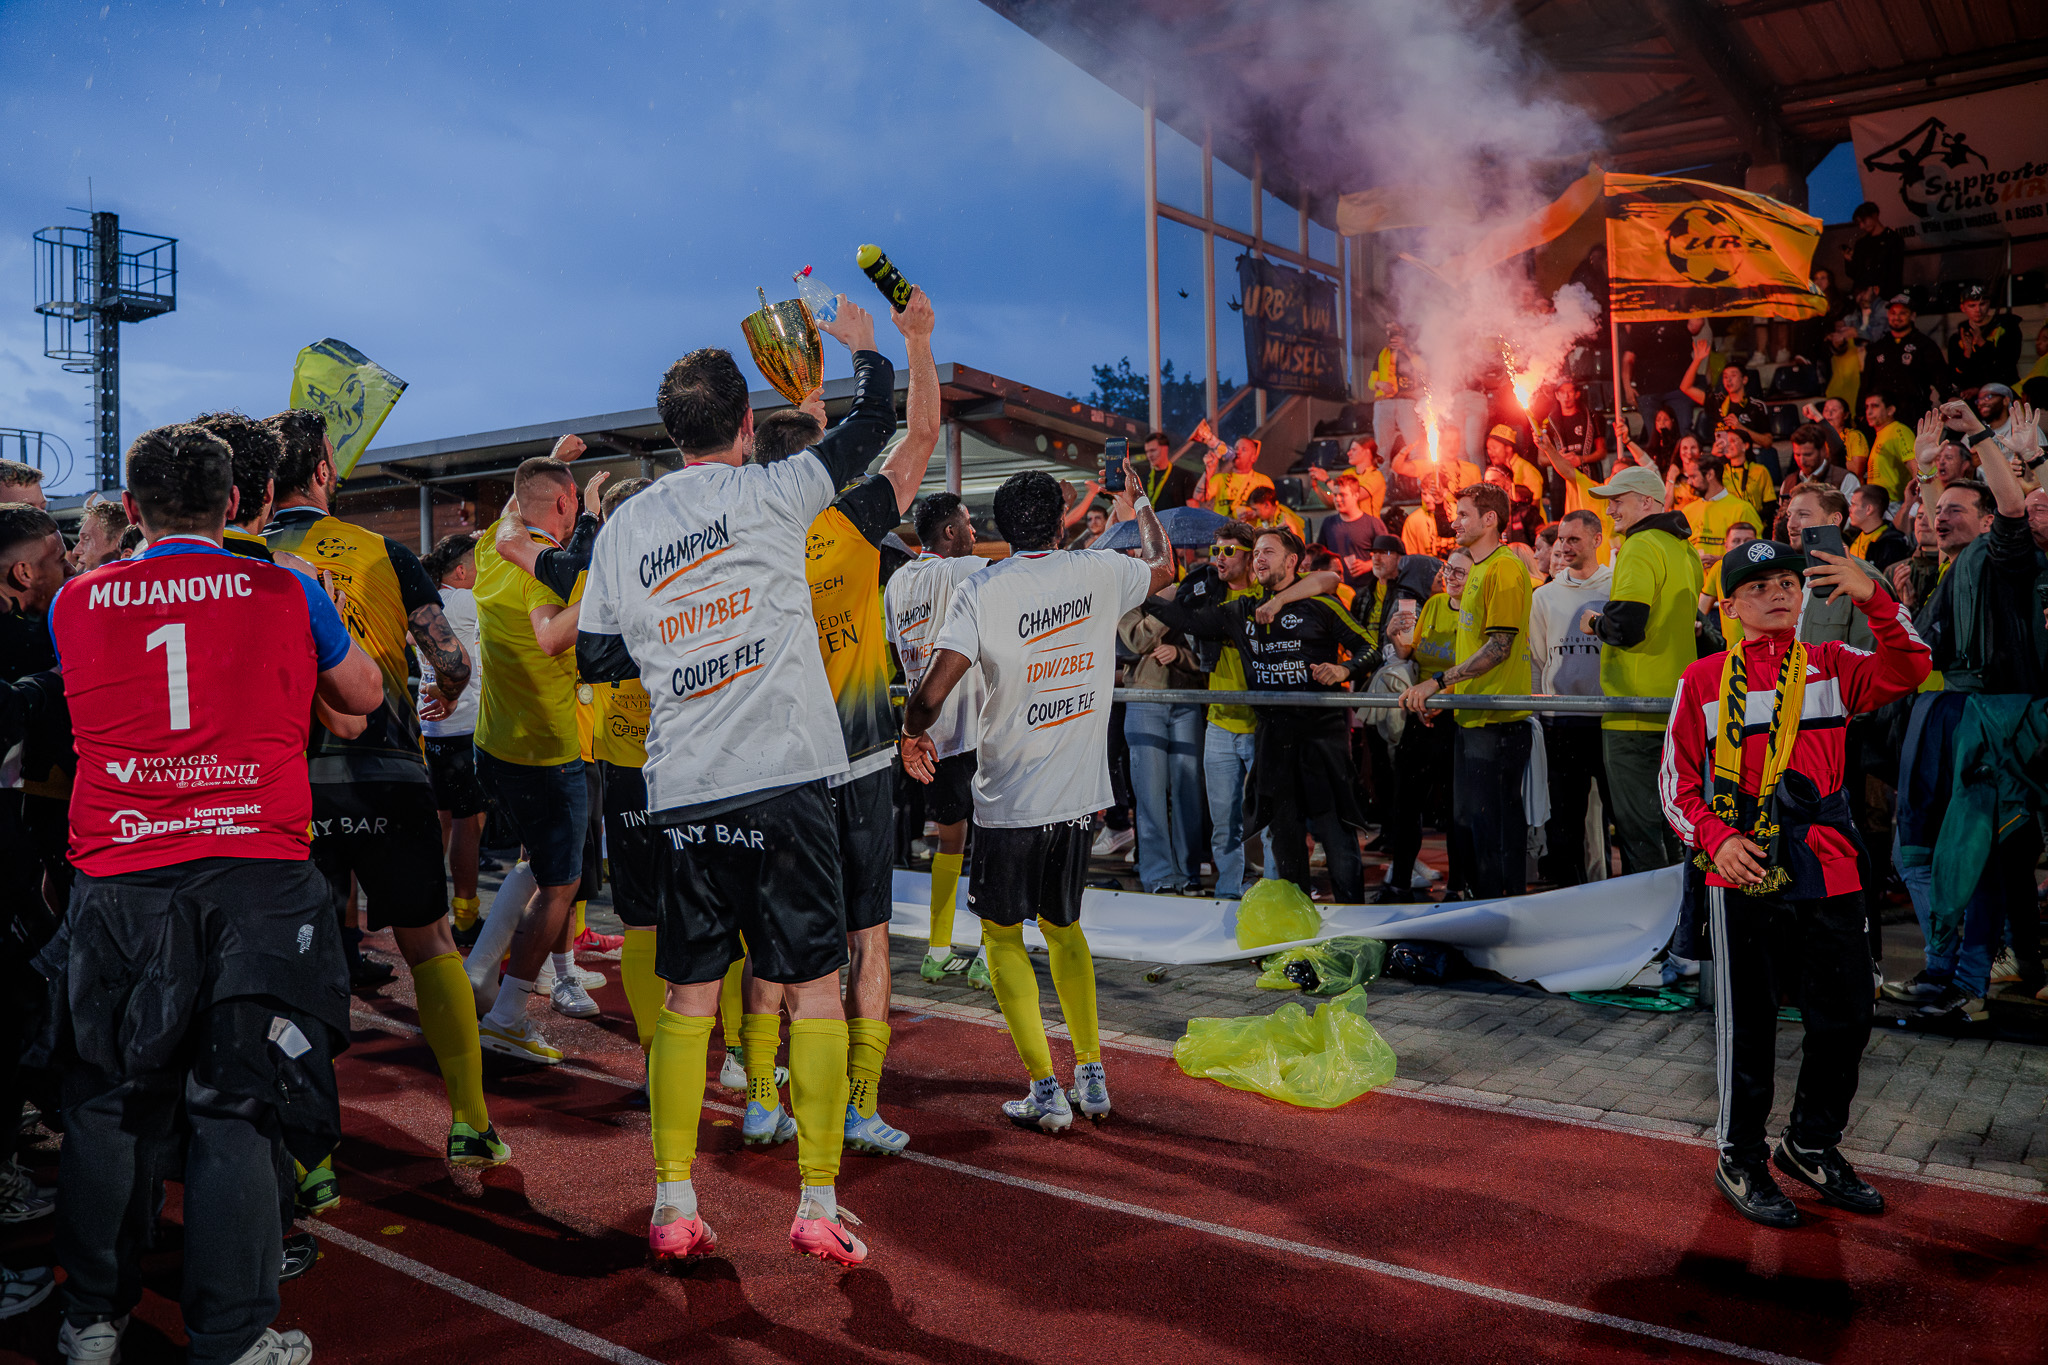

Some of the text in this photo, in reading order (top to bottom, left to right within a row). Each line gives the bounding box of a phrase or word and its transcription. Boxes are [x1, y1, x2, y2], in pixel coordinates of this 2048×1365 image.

[1937, 186, 1999, 213] Club
[640, 511, 729, 589] CHAMPION
[88, 573, 253, 610] MUJANOVIC
[658, 587, 753, 645] 1DIV/2BEZ
[896, 599, 932, 631] CHAMPION
[1018, 591, 1093, 639] CHAMPION
[146, 622, 191, 731] 1
[672, 637, 766, 697] COUPE FLF
[1027, 651, 1095, 684] 1DIV/2BEZ
[1027, 691, 1096, 726] COUPE FLF
[136, 764, 260, 782] VANDIVINIT
[142, 754, 218, 768] VOYAGES
[194, 804, 262, 818] kompakt
[340, 816, 388, 835] BAR
[663, 824, 766, 851] TINY BAR
